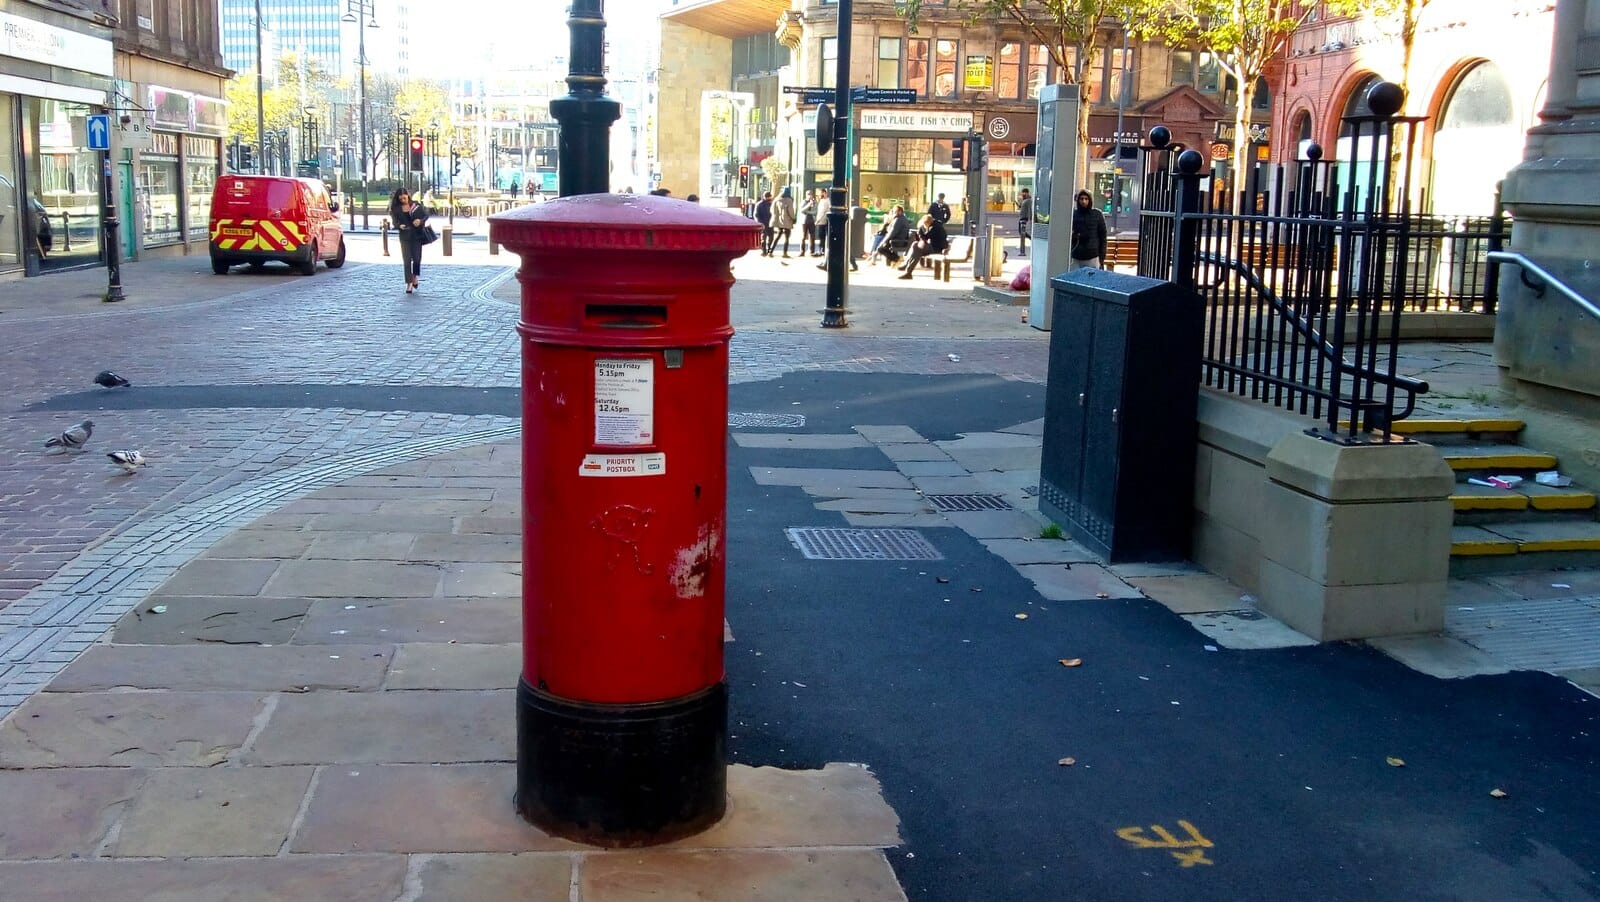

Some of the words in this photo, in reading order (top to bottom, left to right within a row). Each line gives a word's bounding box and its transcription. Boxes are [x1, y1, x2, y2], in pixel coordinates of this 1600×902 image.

[863, 115, 877, 123] THE
[890, 116, 915, 125] PLAICE
[921, 117, 937, 126] FISH
[950, 118, 972, 127] CHIPS
[599, 369, 625, 377] 5.15pm
[599, 404, 630, 413] 12.45pm
